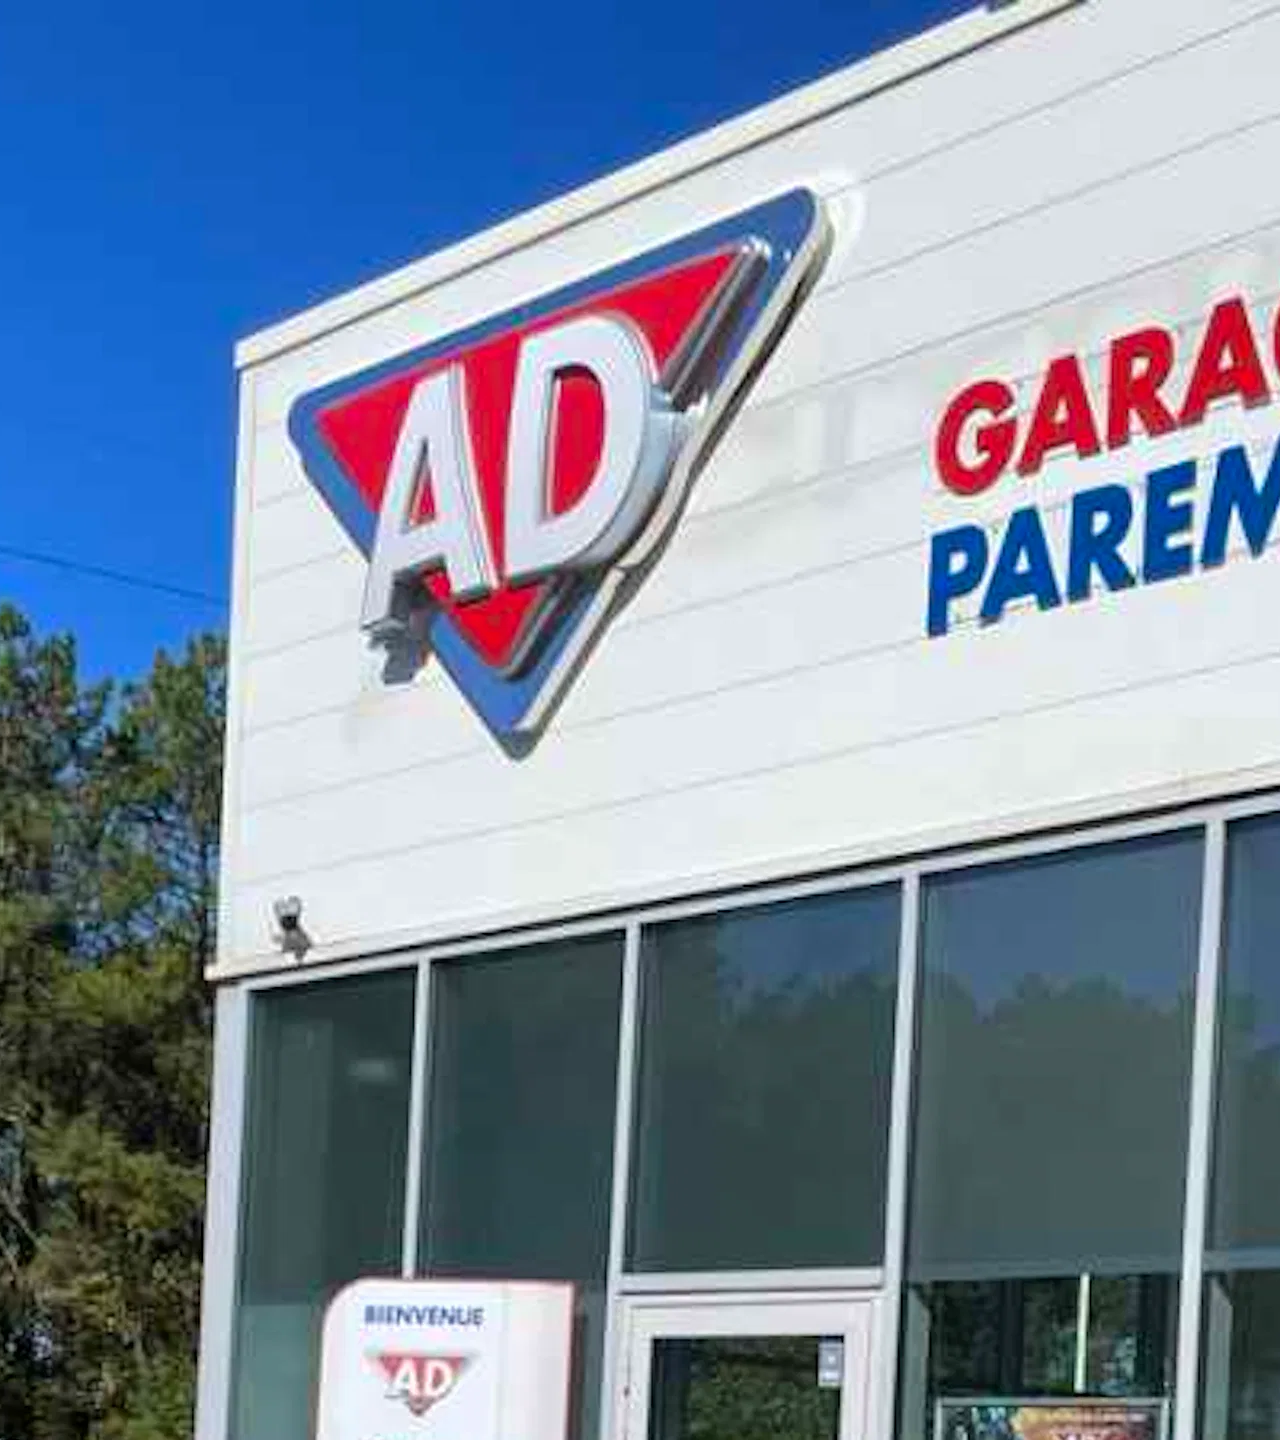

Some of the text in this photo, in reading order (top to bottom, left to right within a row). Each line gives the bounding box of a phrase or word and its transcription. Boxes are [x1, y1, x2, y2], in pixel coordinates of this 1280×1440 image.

[361, 312, 675, 632] AD
[363, 1304, 486, 1327] BIENVENUE
[387, 1356, 455, 1400] AD
